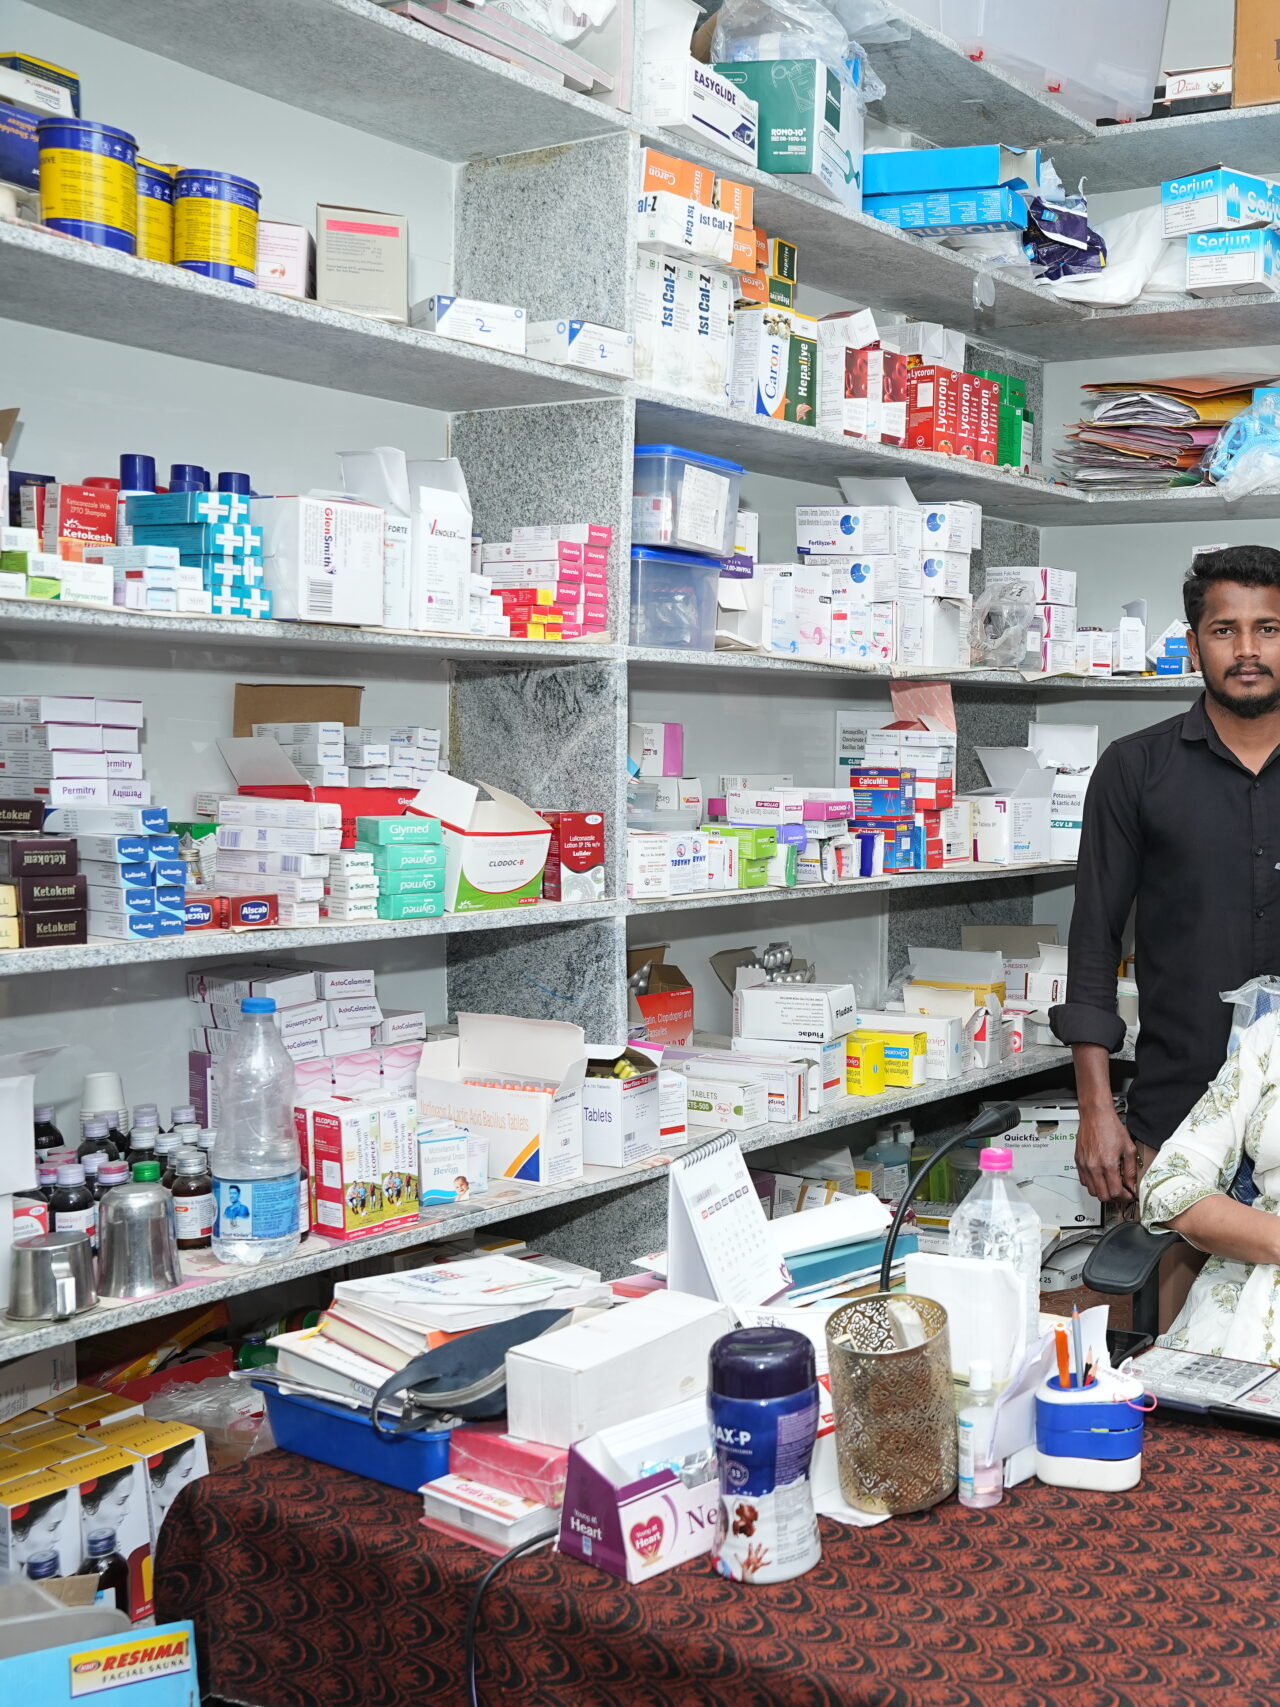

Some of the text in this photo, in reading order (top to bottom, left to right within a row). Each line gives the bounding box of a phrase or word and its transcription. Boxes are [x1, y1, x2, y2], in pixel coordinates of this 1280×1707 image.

[694, 70, 736, 105] EASYGLIDE
[648, 167, 676, 186] Caron
[1170, 176, 1214, 200] Serjun
[637, 196, 658, 213] al-Z
[712, 216, 733, 232] Cal-Z
[685, 221, 693, 245] Cal-Z
[1197, 233, 1251, 255] Serjun
[661, 263, 676, 328] 1st Cal-Z
[698, 273, 711, 336] 1st Cal-Z
[764, 344, 779, 400] Caron
[798, 343, 808, 397] Hepalive
[911, 368, 935, 378] Lycoron
[935, 377, 947, 432] Lycoron
[958, 383, 970, 438] Lycoron
[977, 389, 989, 443] Lycoron
[63, 528, 112, 542] Ketokesh
[387, 524, 408, 535] FORTE
[323, 507, 334, 568] GlenSmith
[107, 760, 132, 769] ermitry
[859, 777, 888, 786] CalcuMin
[62, 786, 96, 796] Permitry
[112, 789, 142, 798] Permitry
[0, 810, 31, 820] etokem
[389, 824, 429, 836] Glymed
[23, 853, 66, 864] Ketokem
[400, 856, 437, 865] Glymed
[400, 880, 436, 890] Glymed
[33, 886, 76, 897] Ketokem
[241, 904, 267, 915] Alscab
[400, 904, 436, 914] Glymed
[36, 922, 77, 933] Ketokem
[331, 978, 371, 987] AstoCalamine
[338, 1005, 376, 1014] AstoCalamine
[684, 1009, 692, 1019] and
[835, 1004, 853, 1019] Fludac
[286, 1015, 323, 1028] AstoCalamine
[286, 1038, 318, 1050] toCalamine
[678, 1038, 685, 1046] 10
[691, 1090, 718, 1099] TABLETS
[688, 1102, 709, 1110] ETS-500
[584, 1106, 613, 1123] Tablets
[315, 1116, 338, 1127] ELCOPLEX
[507, 1113, 529, 1131] Tablets
[1004, 1134, 1040, 1142] Quickfix
[571, 1520, 602, 1540] Heart
[635, 1533, 661, 1551] Heart
[102, 1640, 184, 1672] RESHMA
[102, 1658, 184, 1684] FACIAL SAUNA
